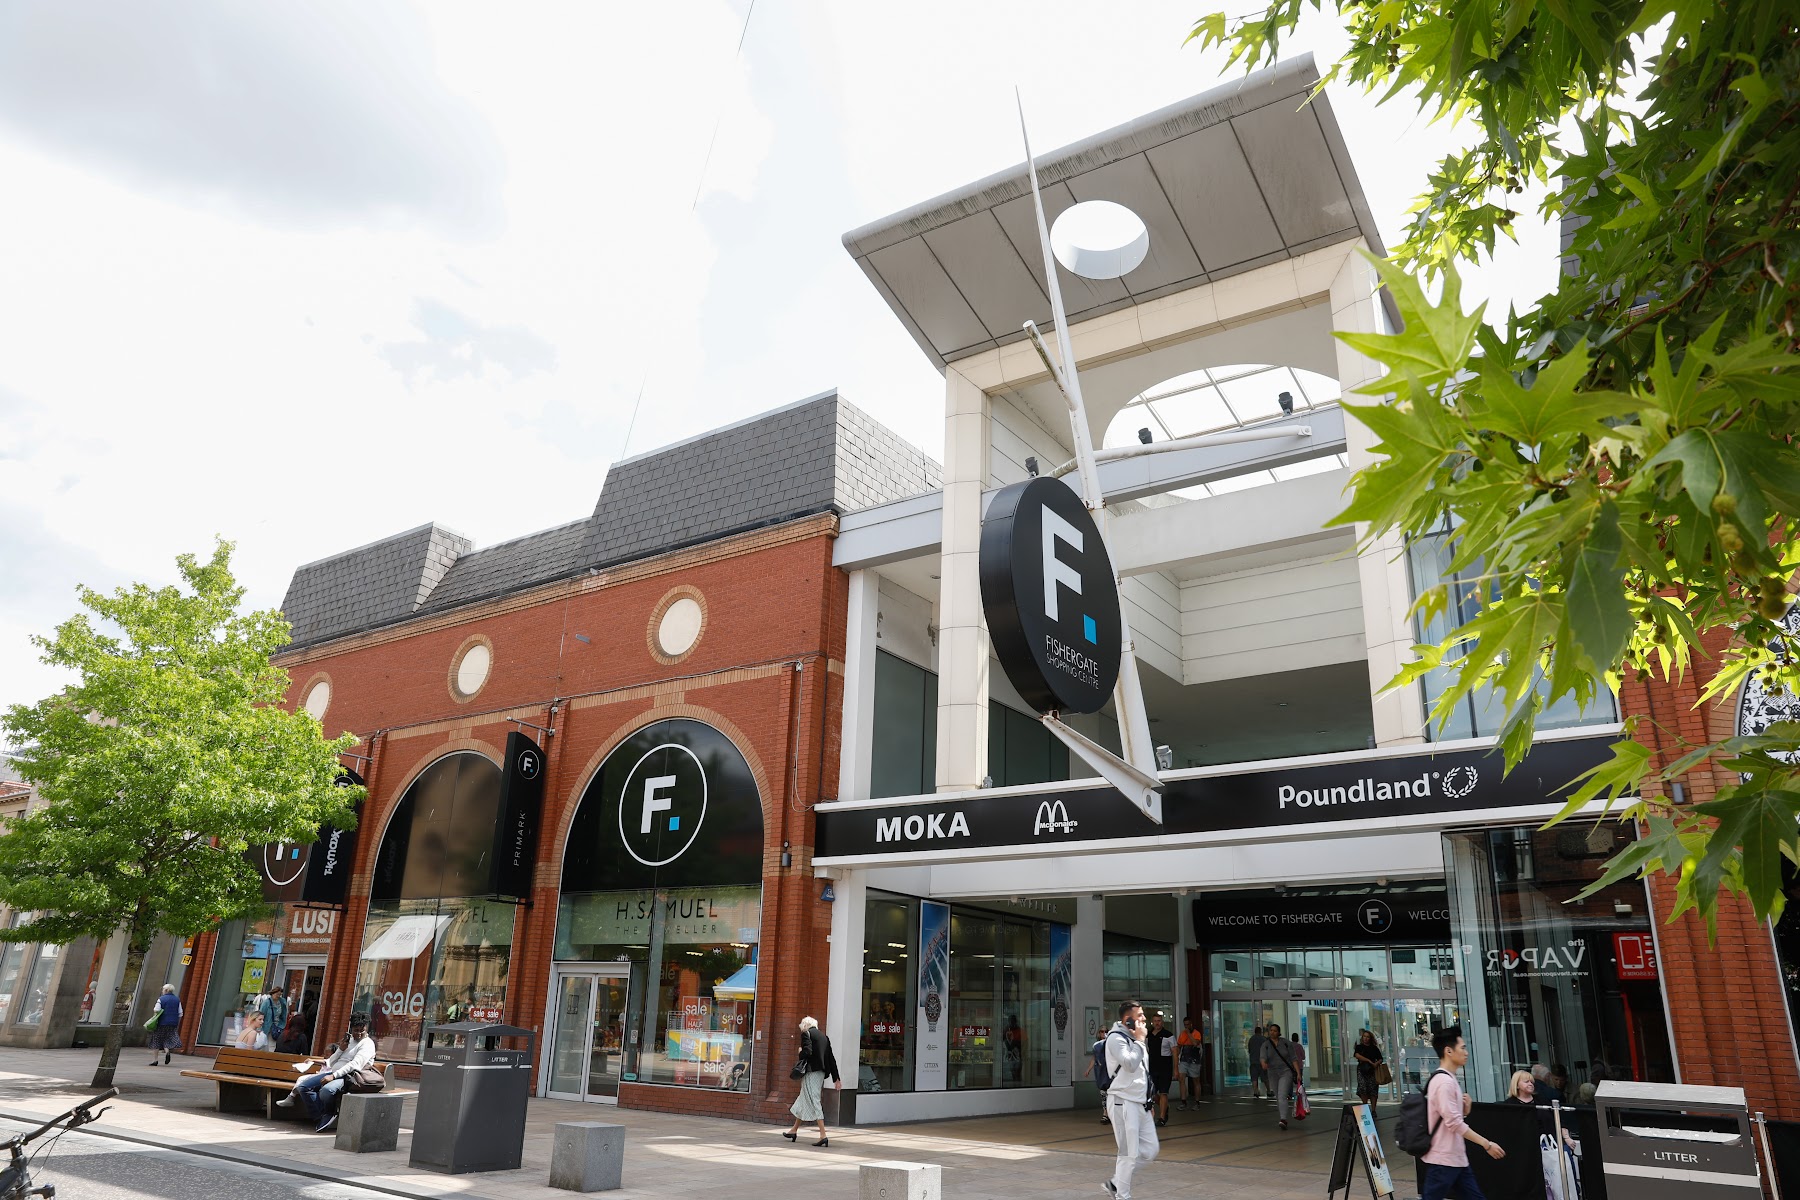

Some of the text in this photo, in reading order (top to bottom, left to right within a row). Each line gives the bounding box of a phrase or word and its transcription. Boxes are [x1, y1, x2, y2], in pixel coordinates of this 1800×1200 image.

[1045, 634, 1099, 678] FISHERGATE
[1045, 652, 1100, 690] SHOPPING CENTRE
[1278, 772, 1432, 809] Poundland
[875, 811, 971, 843] MOKA
[1039, 819, 1079, 829] McDonald's
[513, 811, 527, 867] PRIMARK
[1208, 912, 1343, 926] WELCOME TO FISHERGATE
[615, 926, 638, 936] THE
[382, 987, 425, 1017] sale
[685, 1002, 708, 1016] sale
[473, 1008, 499, 1019] sale sale
[687, 1020, 703, 1028] HALF
[873, 1021, 901, 1034] sale sale
[964, 1025, 987, 1036] sale sale
[703, 1059, 726, 1074] sale
[1653, 1150, 1699, 1163] LITTER
